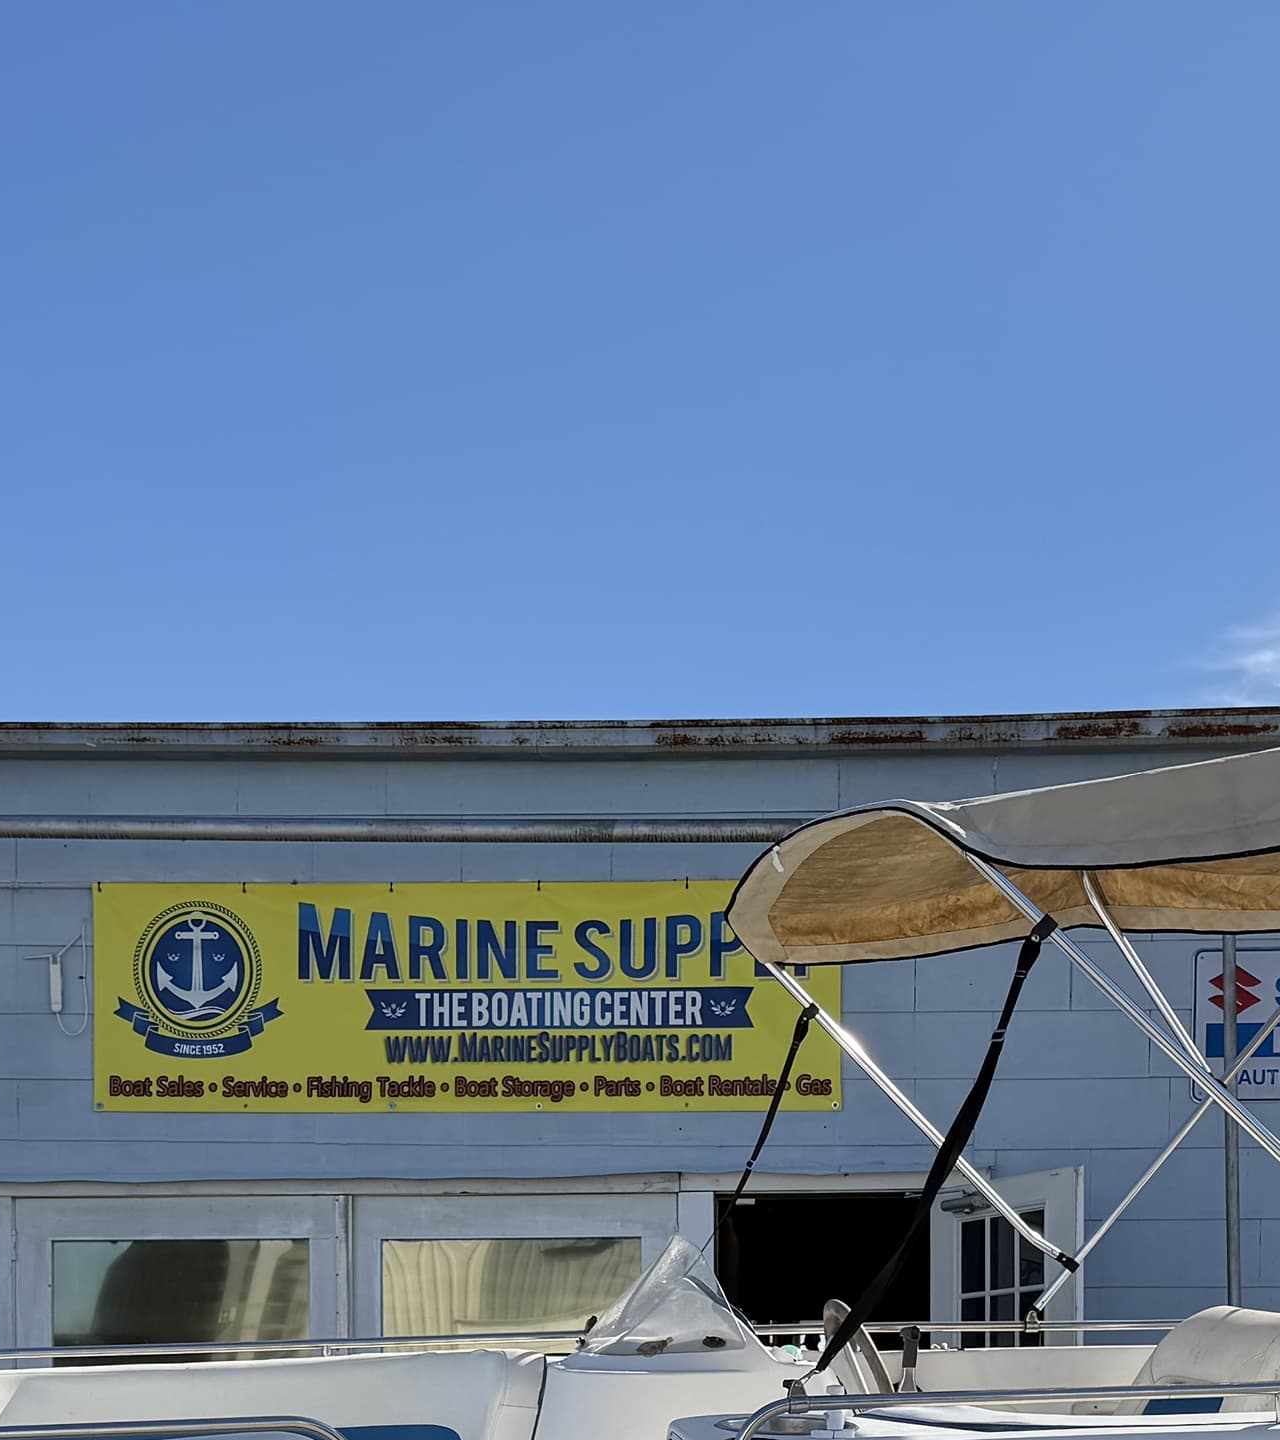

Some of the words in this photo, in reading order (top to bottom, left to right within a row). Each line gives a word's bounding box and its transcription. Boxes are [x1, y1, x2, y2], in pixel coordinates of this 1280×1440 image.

[298, 902, 561, 981] MARINE
[574, 911, 807, 981] SUPP
[415, 991, 468, 1027] THE
[472, 991, 591, 1027] BOATING
[595, 990, 703, 1026] CENTER
[173, 1043, 202, 1055] SINCE
[202, 1043, 225, 1055] 1952
[109, 1076, 153, 1097] Boat
[157, 1075, 205, 1097] Sales
[223, 1076, 289, 1097] Service
[307, 1076, 372, 1102] Fishing
[377, 1075, 436, 1097] Tackle
[454, 1076, 498, 1097] Boat
[502, 1076, 576, 1102] Storage
[594, 1075, 642, 1097] Parts
[660, 1075, 704, 1097] Boat
[708, 1074, 779, 1097] Rentals
[795, 1075, 833, 1096] Gas
